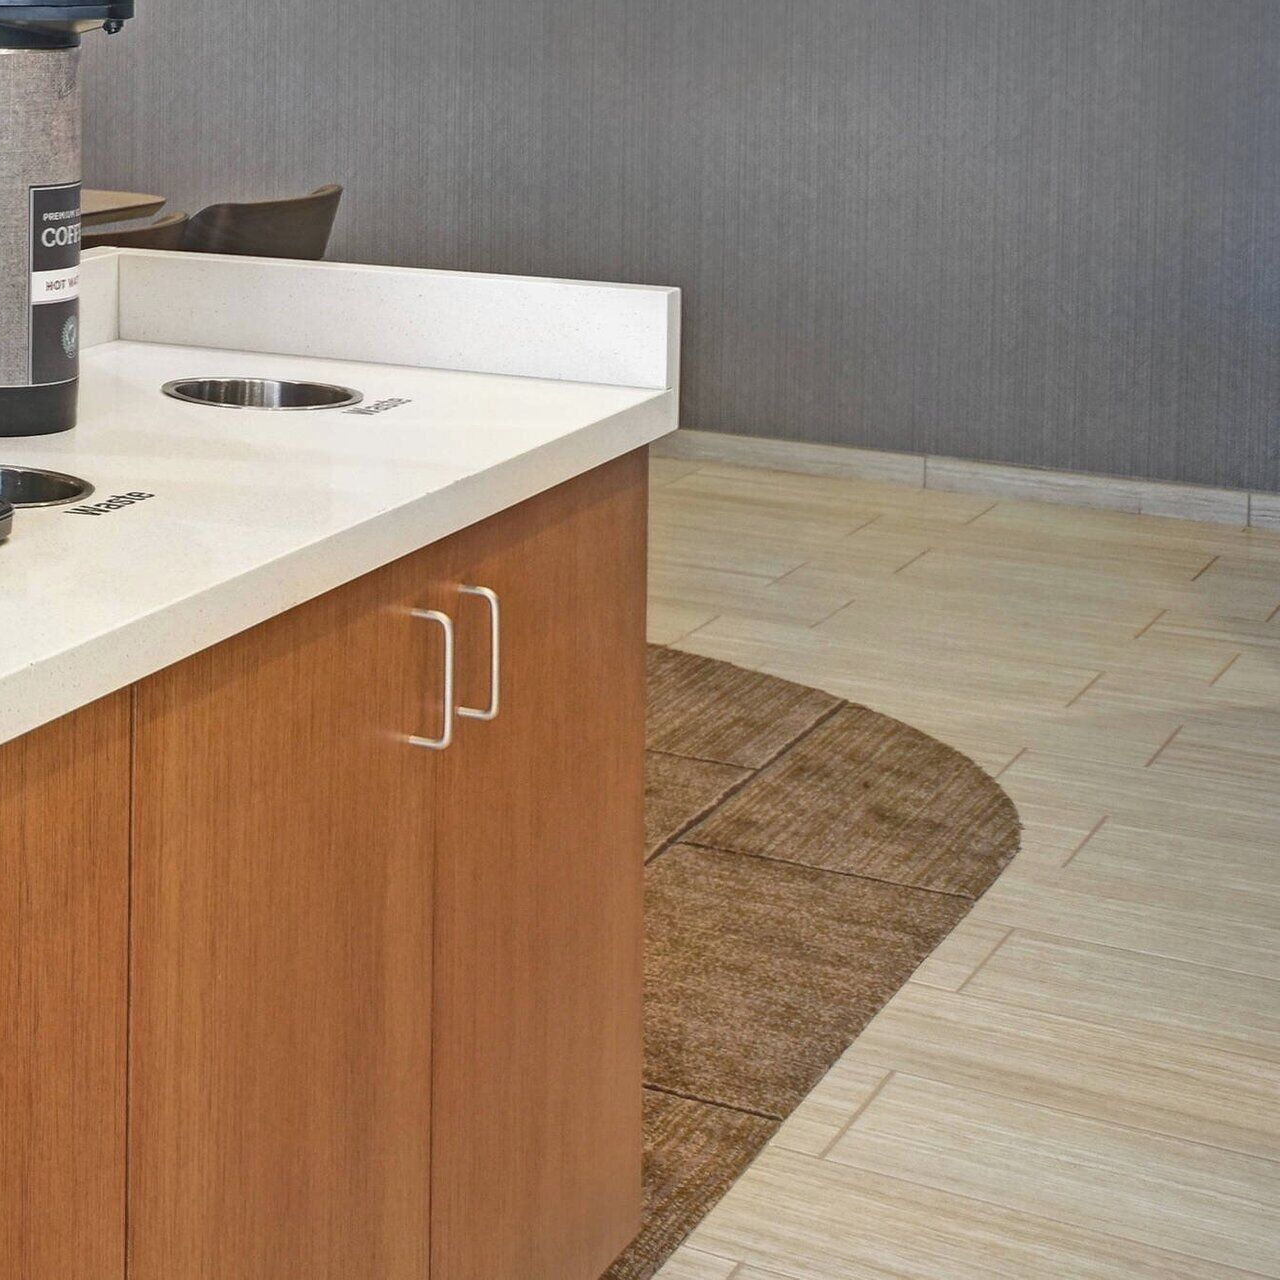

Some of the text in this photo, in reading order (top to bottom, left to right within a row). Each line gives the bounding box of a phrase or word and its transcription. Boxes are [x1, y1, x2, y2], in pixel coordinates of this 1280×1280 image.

[42, 208, 75, 221] PREMIUM
[41, 222, 81, 248] COFF
[46, 280, 65, 291] HOT
[341, 396, 412, 416] Waste
[64, 490, 156, 517] Waste
